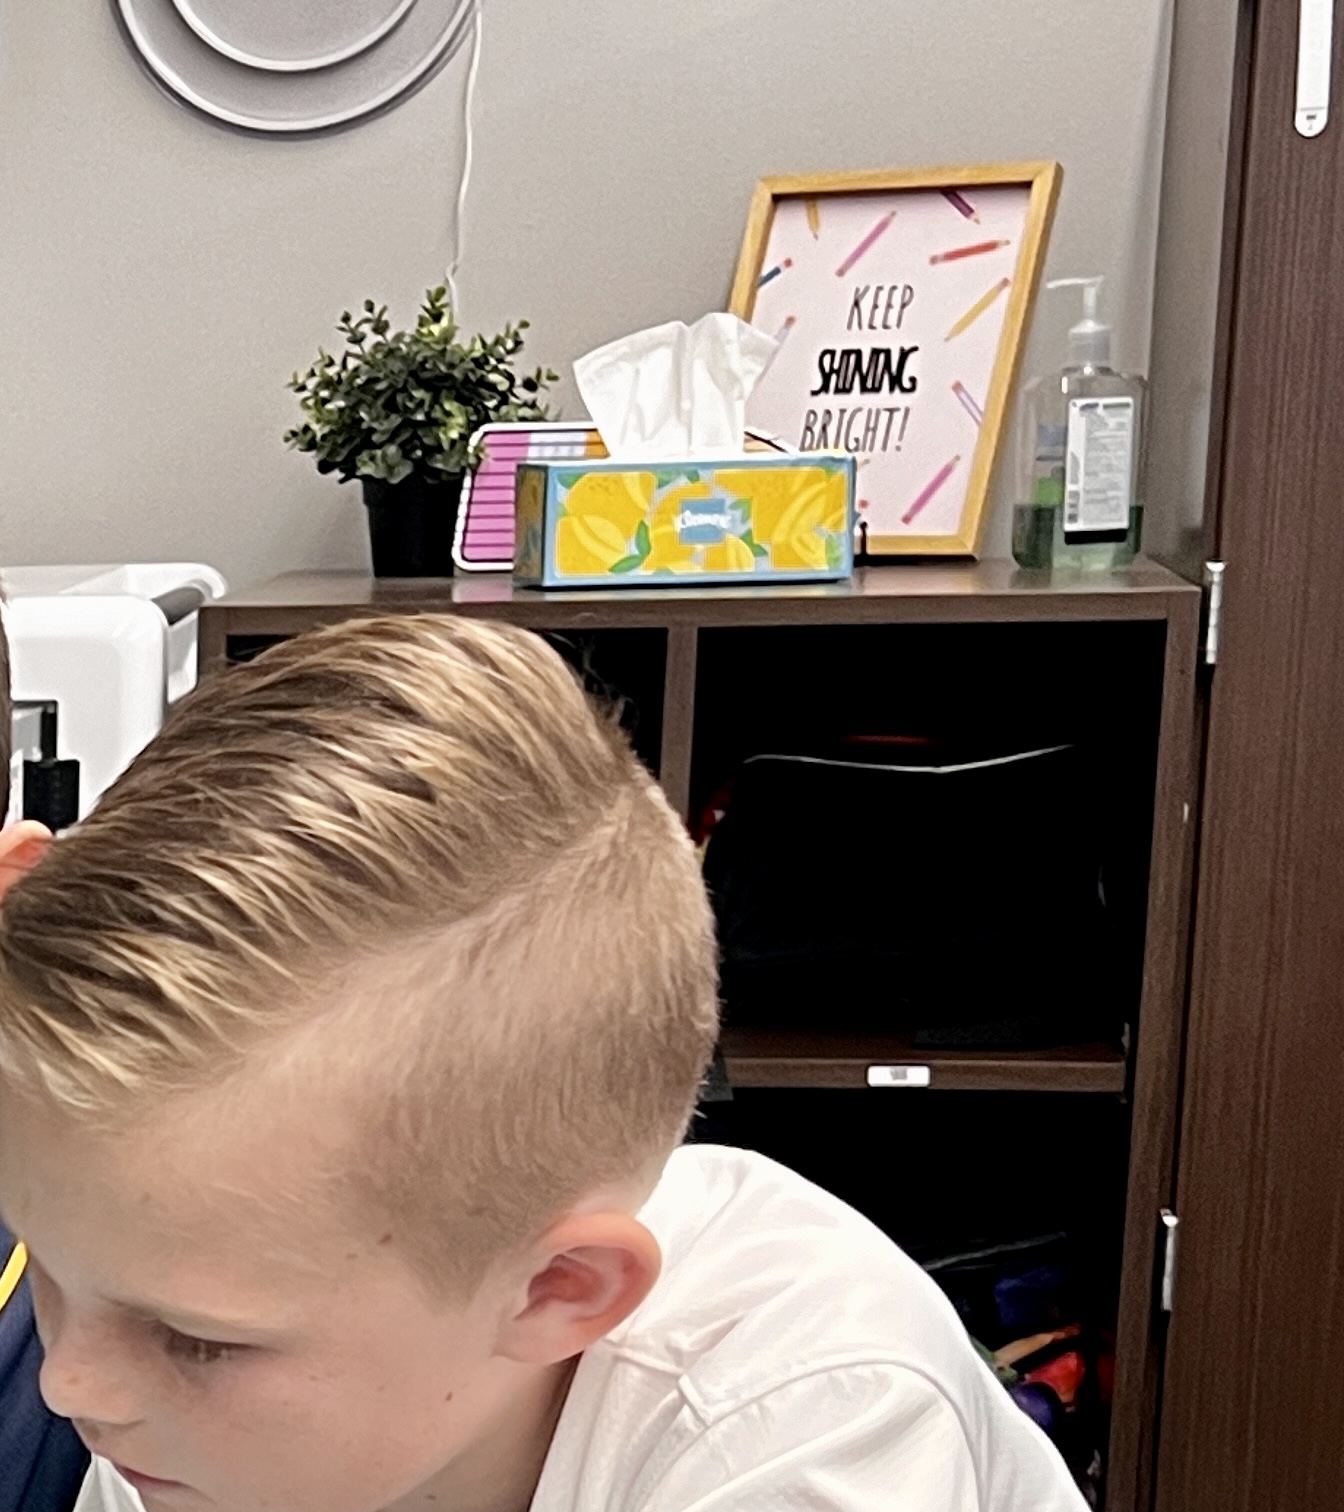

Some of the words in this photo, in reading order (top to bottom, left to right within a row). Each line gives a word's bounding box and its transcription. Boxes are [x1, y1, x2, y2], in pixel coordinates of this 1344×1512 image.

[846, 284, 914, 331] KEEP
[810, 345, 919, 396] SHINING
[799, 406, 911, 453] BRIGHT!
